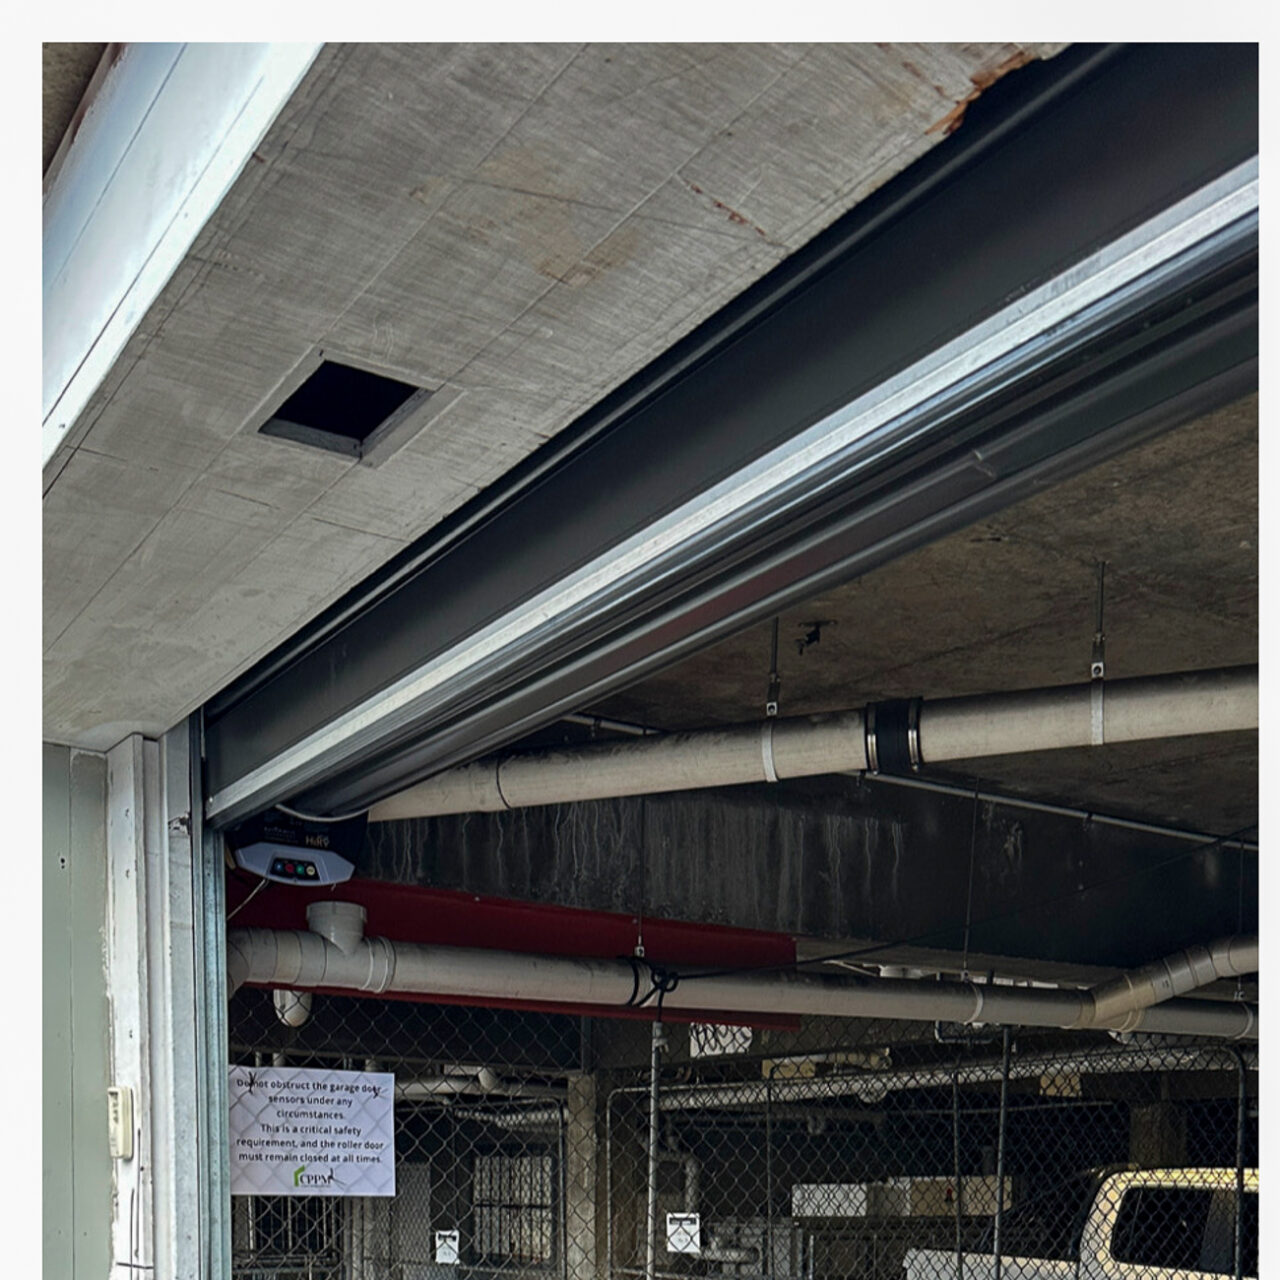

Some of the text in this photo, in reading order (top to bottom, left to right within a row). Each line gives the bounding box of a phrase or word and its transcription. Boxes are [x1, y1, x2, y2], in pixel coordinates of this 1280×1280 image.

[271, 1081, 309, 1090] obstruct
[313, 1082, 327, 1090] the
[330, 1084, 359, 1093] garage
[268, 1096, 353, 1108] sensors under any
[261, 1124, 280, 1133] This
[283, 1124, 290, 1133] is
[300, 1125, 331, 1134] critical
[334, 1127, 361, 1137] safety
[300, 1140, 317, 1148] and
[320, 1140, 334, 1149] the
[337, 1141, 363, 1149] roller
[364, 1141, 384, 1149] door
[239, 1152, 262, 1161] must
[265, 1152, 297, 1161] remain
[300, 1153, 328, 1162] closed
[331, 1154, 340, 1162] at
[343, 1154, 353, 1162] all
